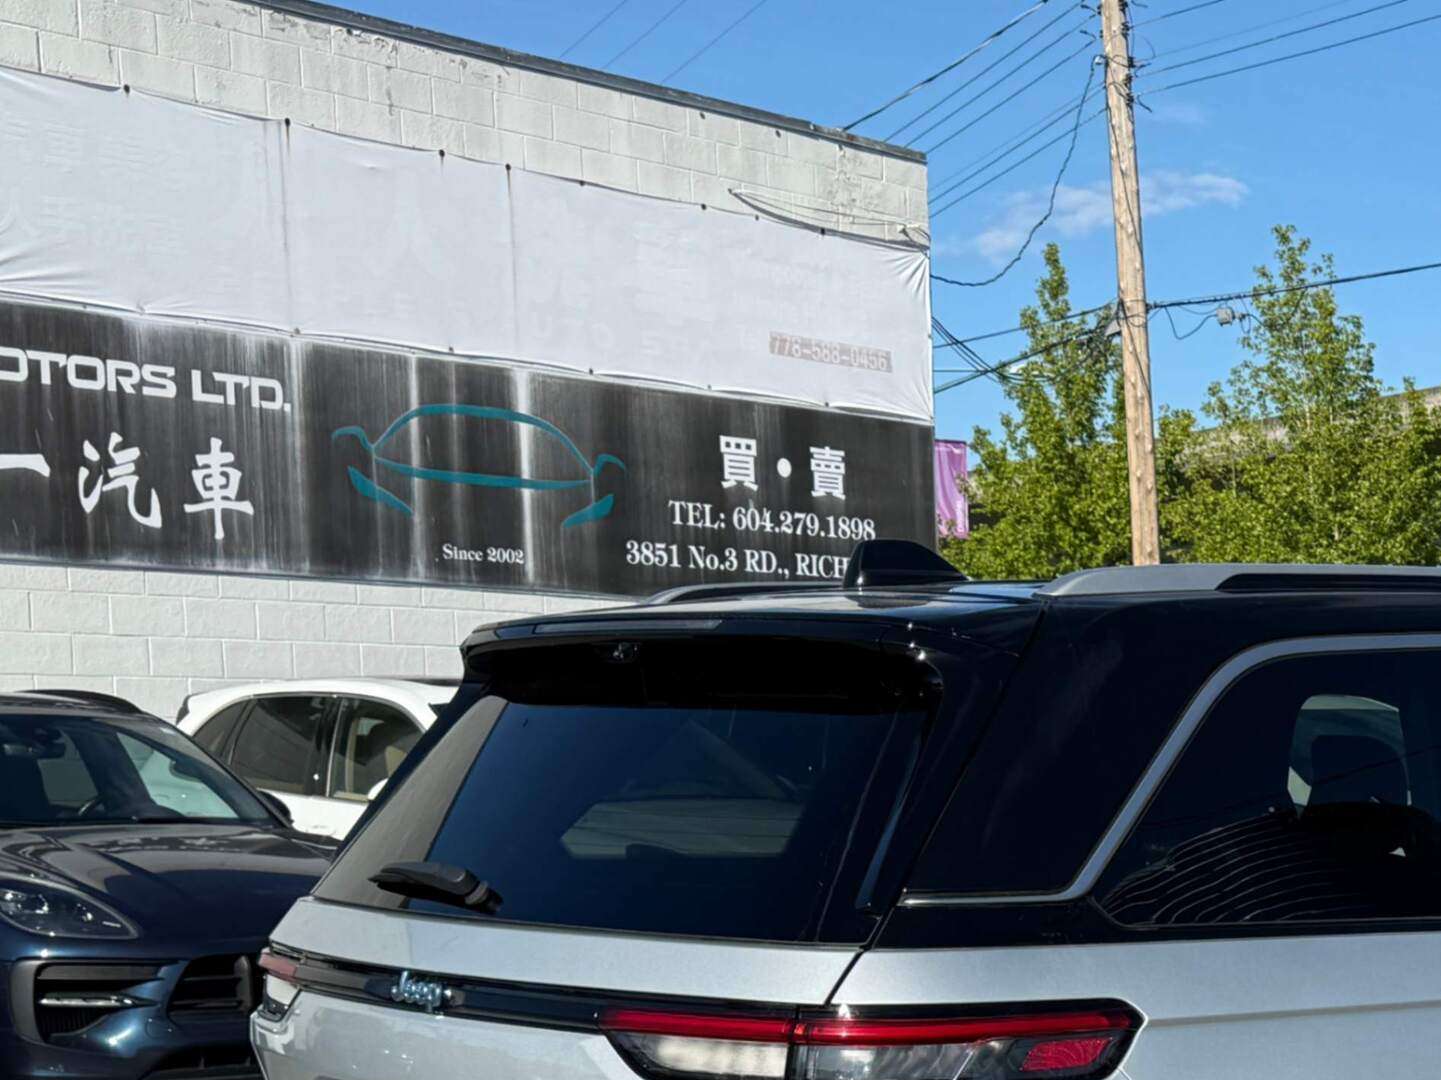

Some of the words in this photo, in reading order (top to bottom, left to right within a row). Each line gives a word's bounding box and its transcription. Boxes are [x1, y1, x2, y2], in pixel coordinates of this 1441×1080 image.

[0, 347, 176, 399] OTORS
[191, 369, 291, 412] LTD.
[668, 500, 726, 530] TEL:
[732, 507, 876, 541] 604.279.1898
[442, 543, 484, 562] Since
[486, 547, 525, 565] 2002
[625, 540, 682, 568] 3851
[688, 545, 739, 572] No.3
[744, 550, 790, 579] RD.,
